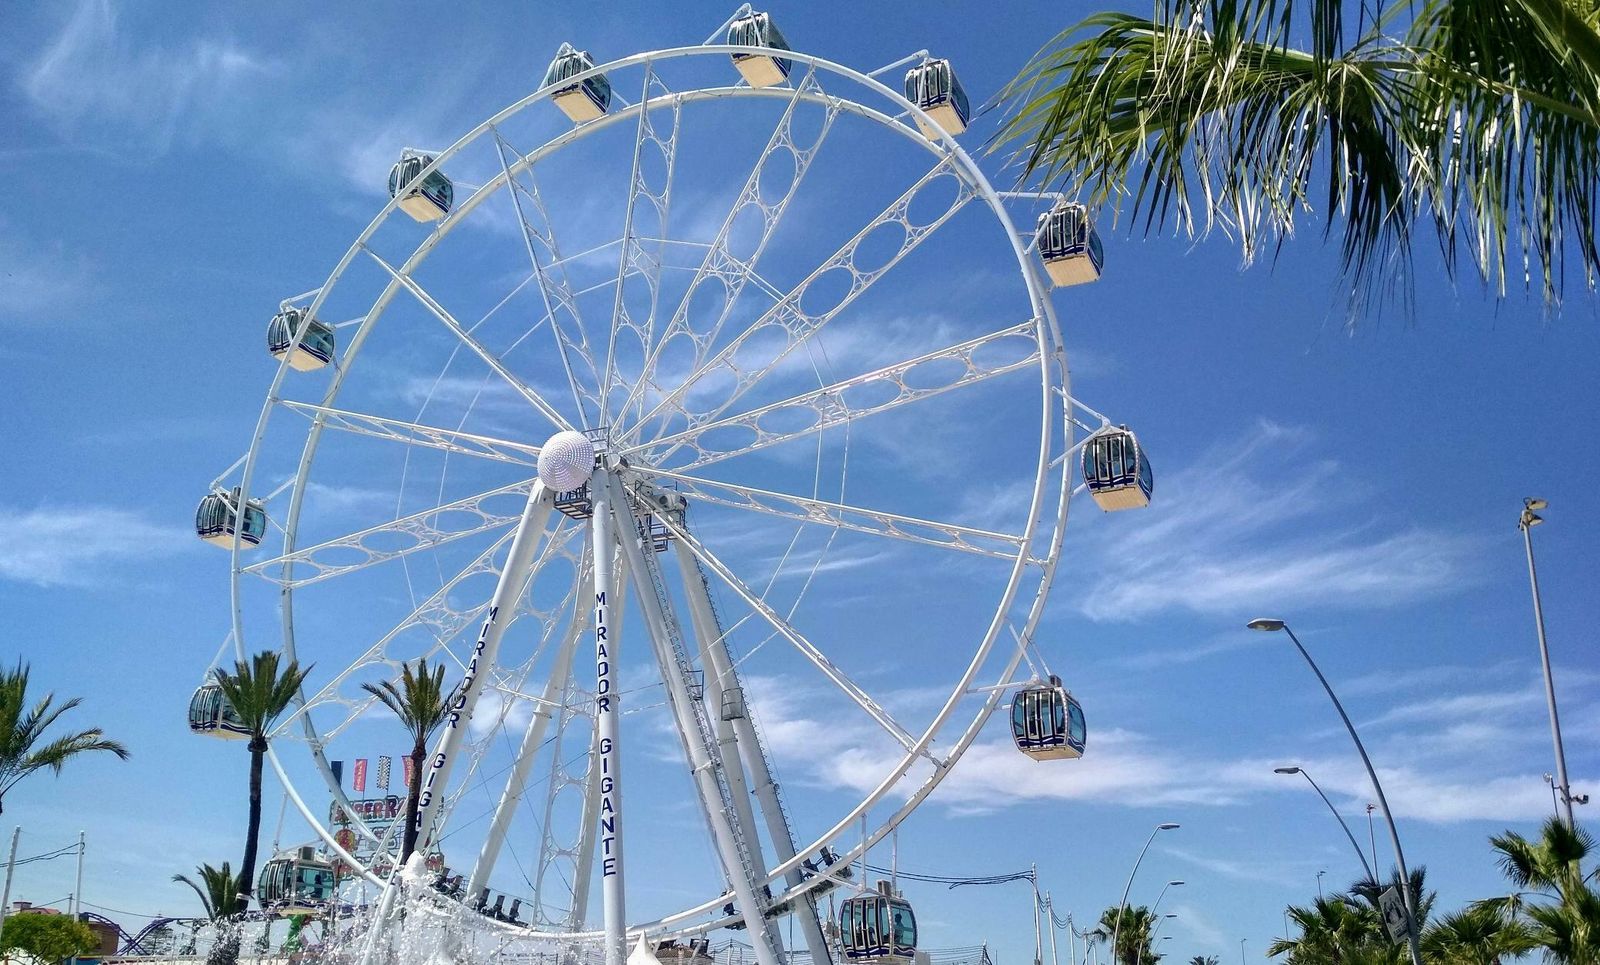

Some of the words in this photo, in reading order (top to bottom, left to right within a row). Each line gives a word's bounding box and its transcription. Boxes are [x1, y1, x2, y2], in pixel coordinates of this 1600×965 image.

[447, 606, 499, 729] MIRADOR
[596, 591, 610, 714] MIRADOR
[416, 753, 446, 828] GIGA
[600, 738, 616, 877] GIGANTE
